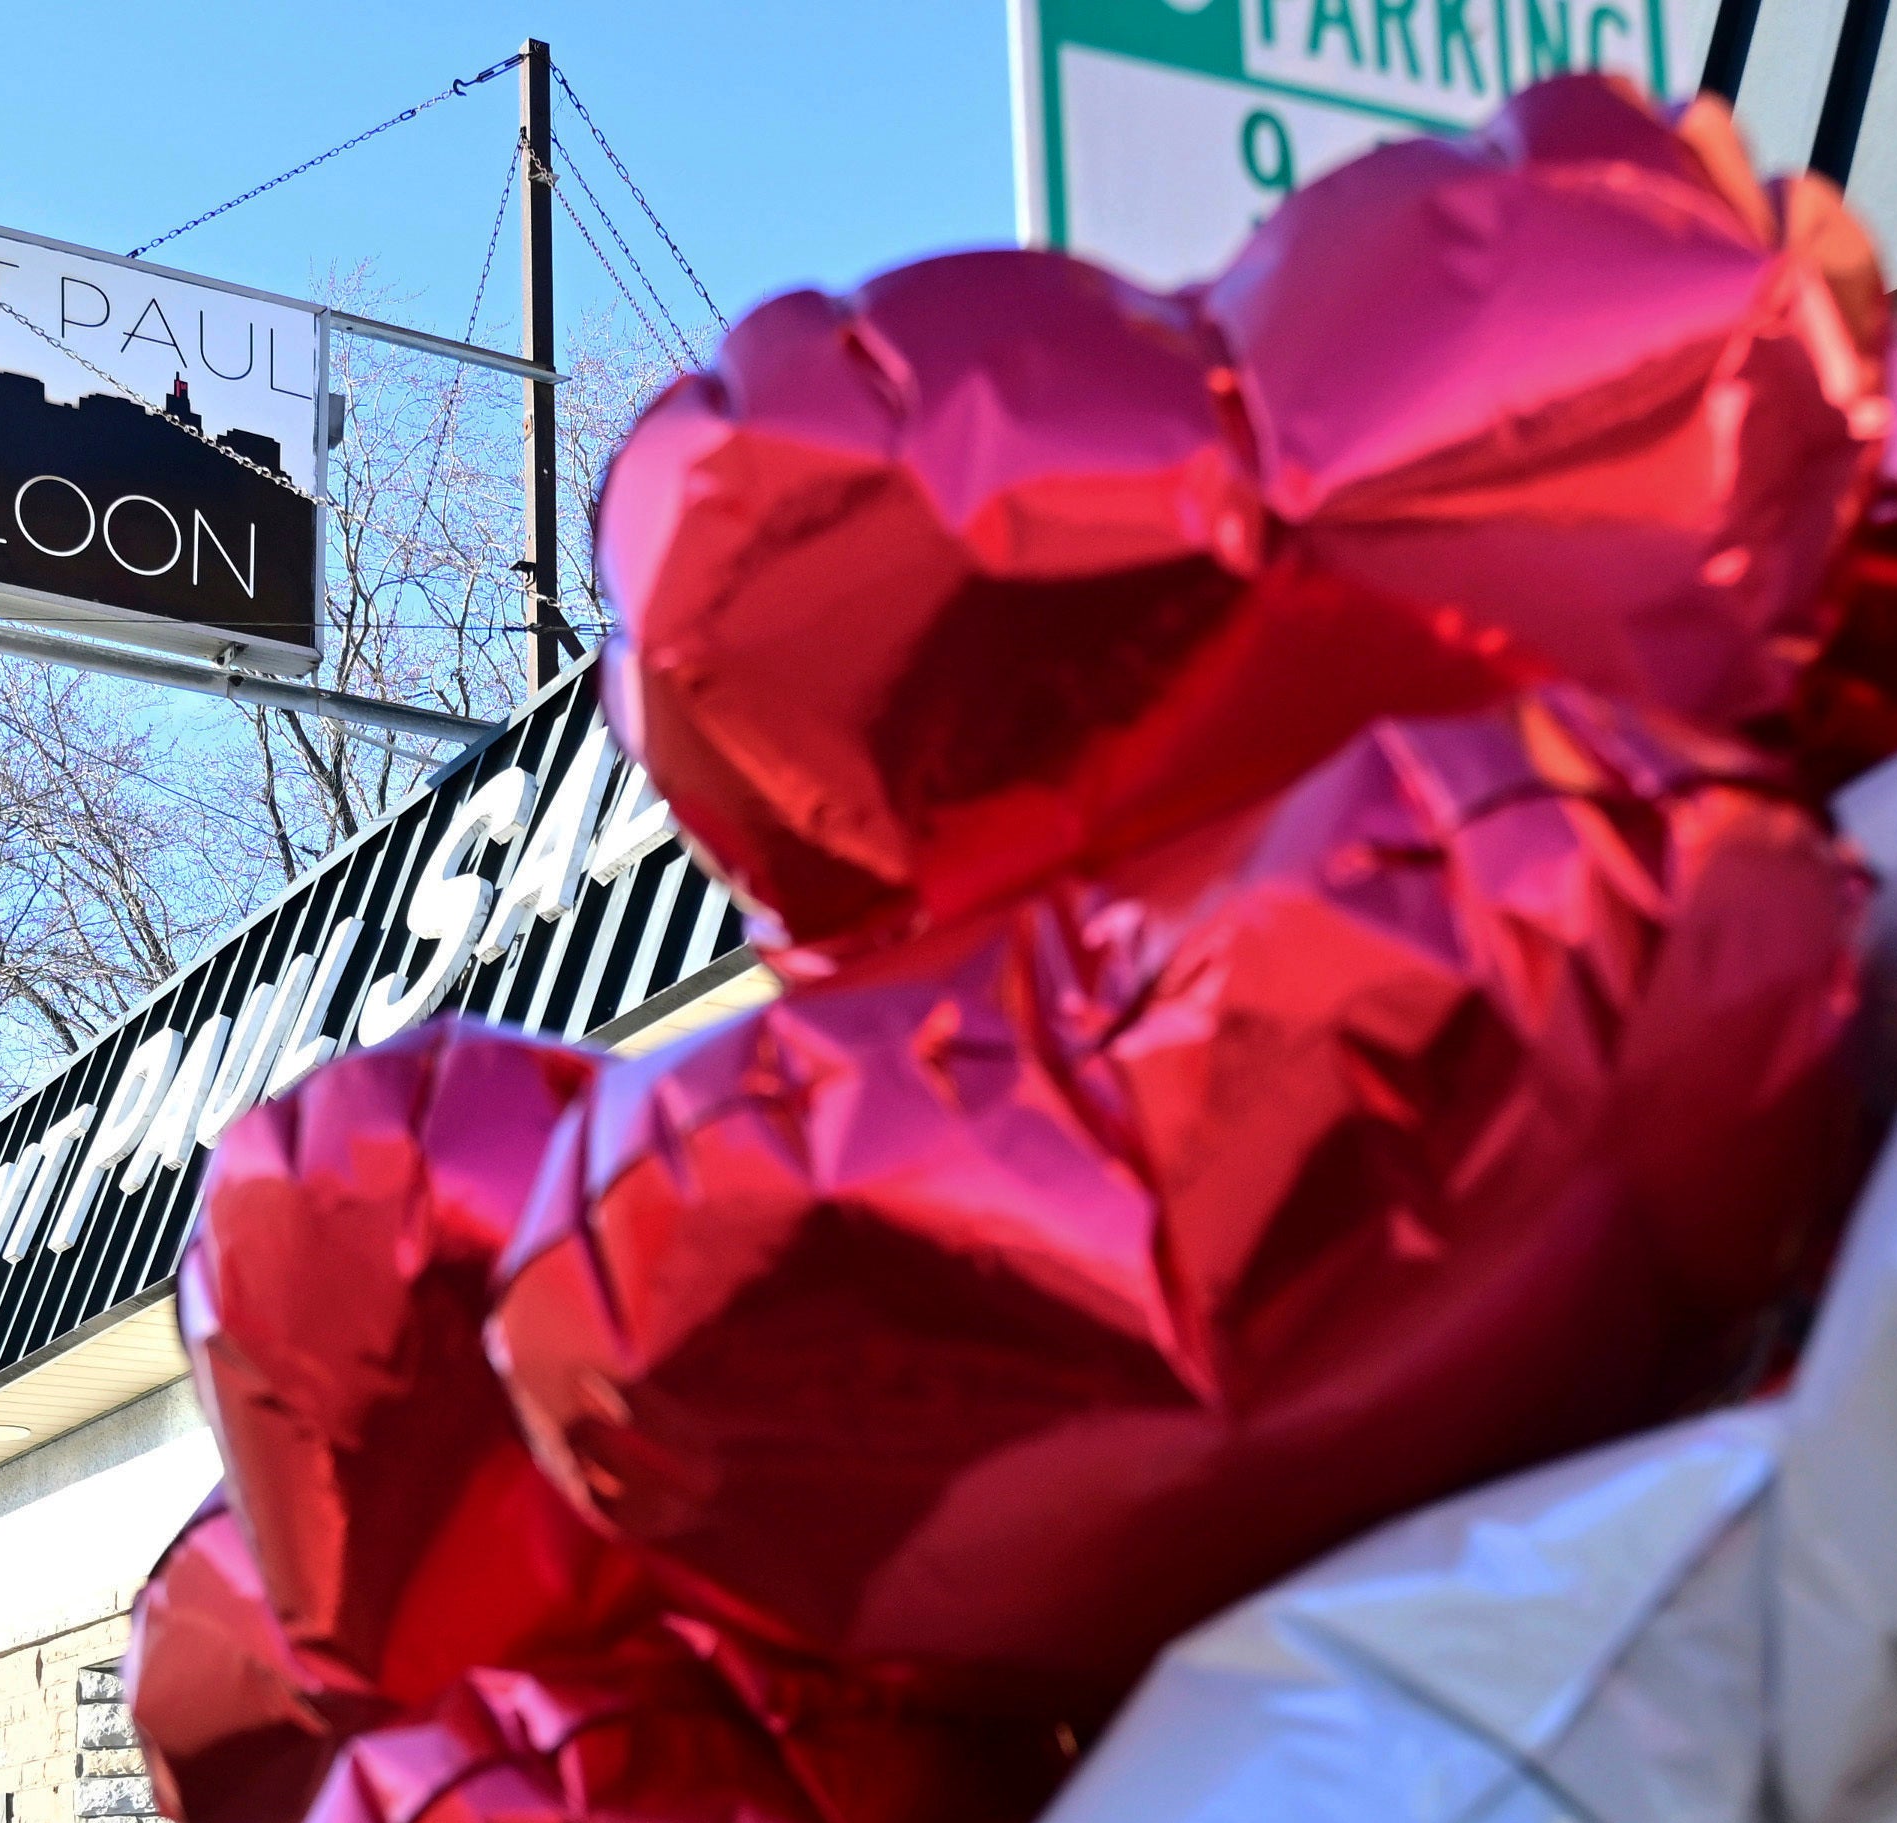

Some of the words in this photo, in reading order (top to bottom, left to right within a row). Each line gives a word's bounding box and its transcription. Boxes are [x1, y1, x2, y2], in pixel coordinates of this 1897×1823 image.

[60, 276, 314, 400] PAUL
[48, 917, 364, 1254] PAUL
[358, 725, 680, 1047] SAL
